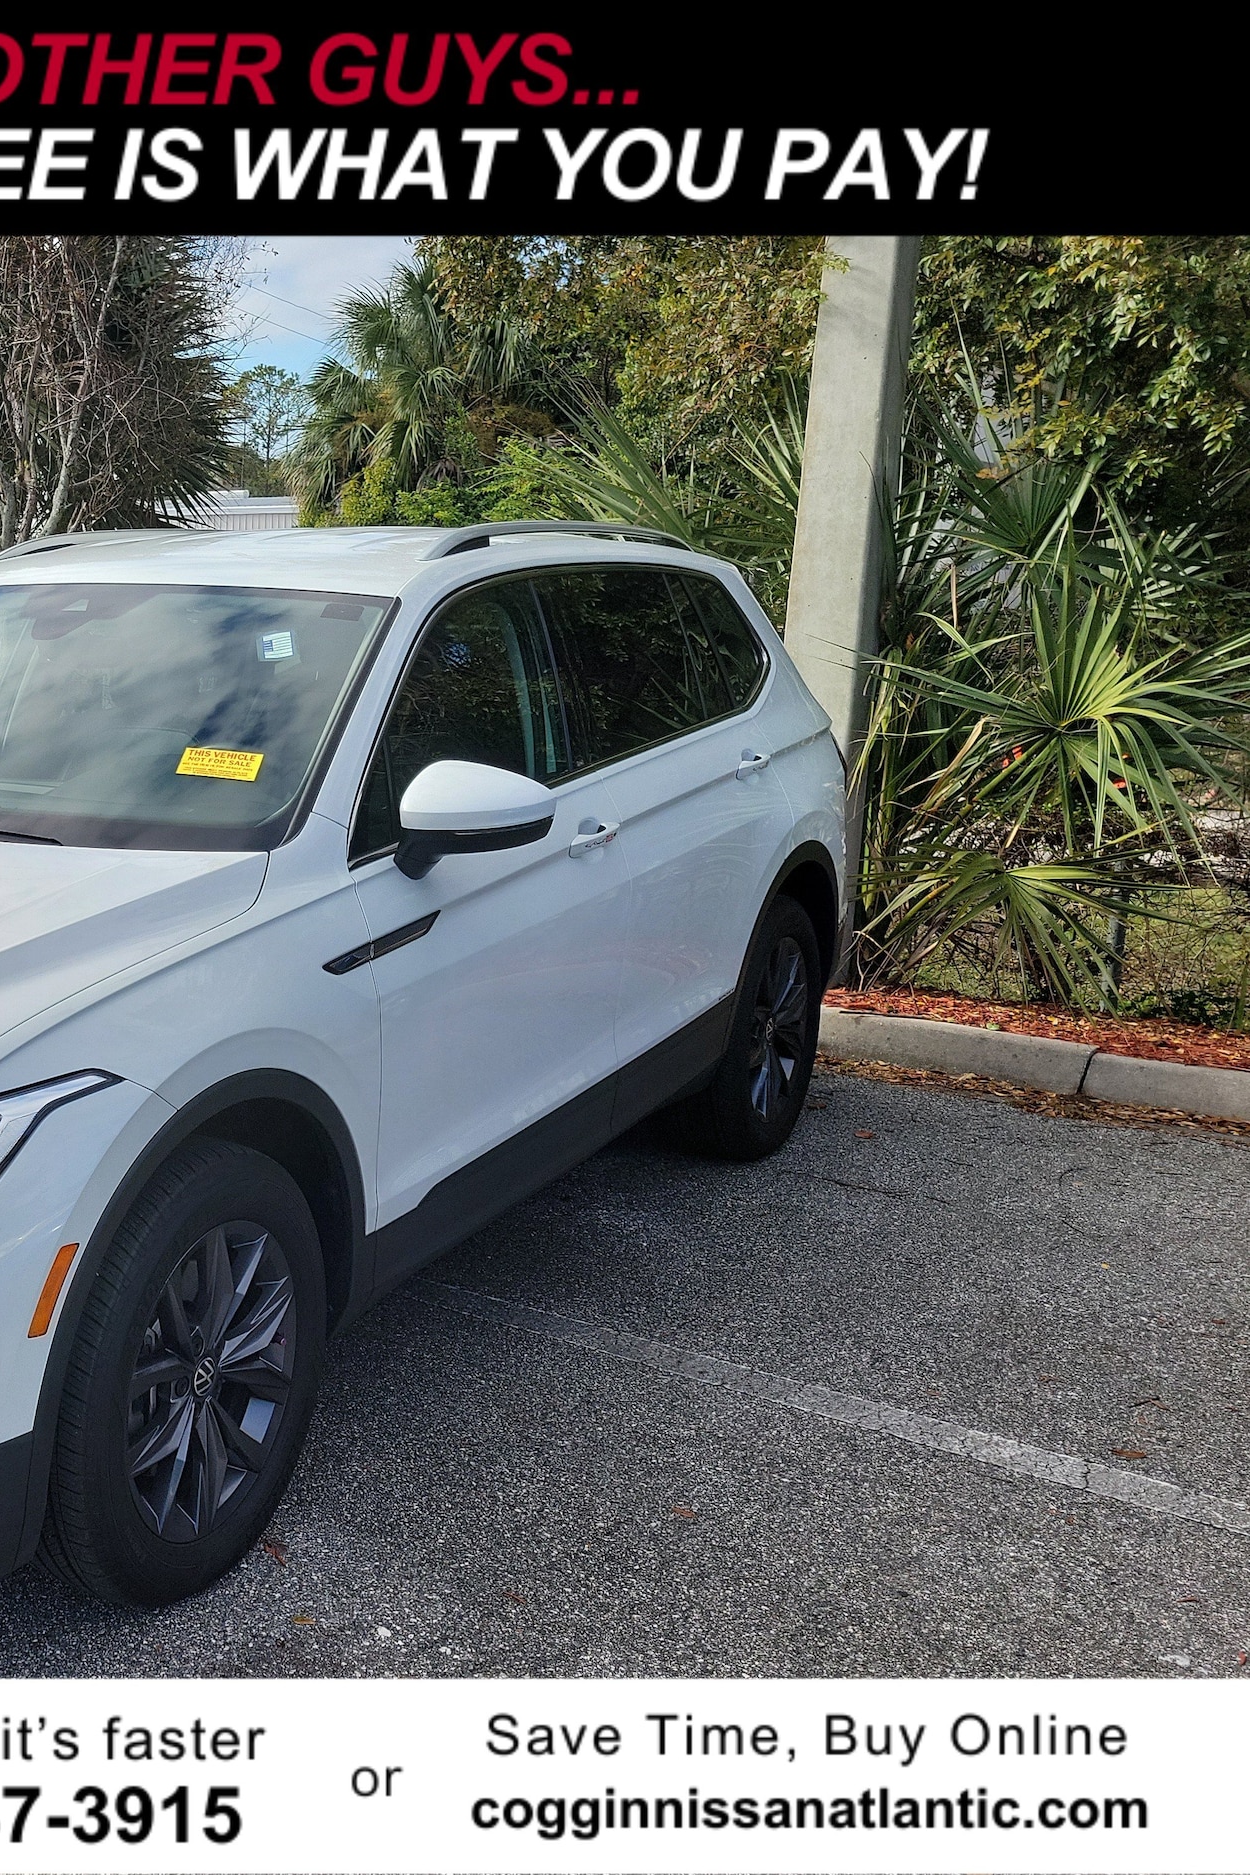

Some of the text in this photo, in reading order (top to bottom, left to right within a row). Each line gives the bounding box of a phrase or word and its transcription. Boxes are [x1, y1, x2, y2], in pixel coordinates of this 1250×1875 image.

[189, 749, 257, 762] THIS VEHICLE
[229, 759, 252, 767] SALE
